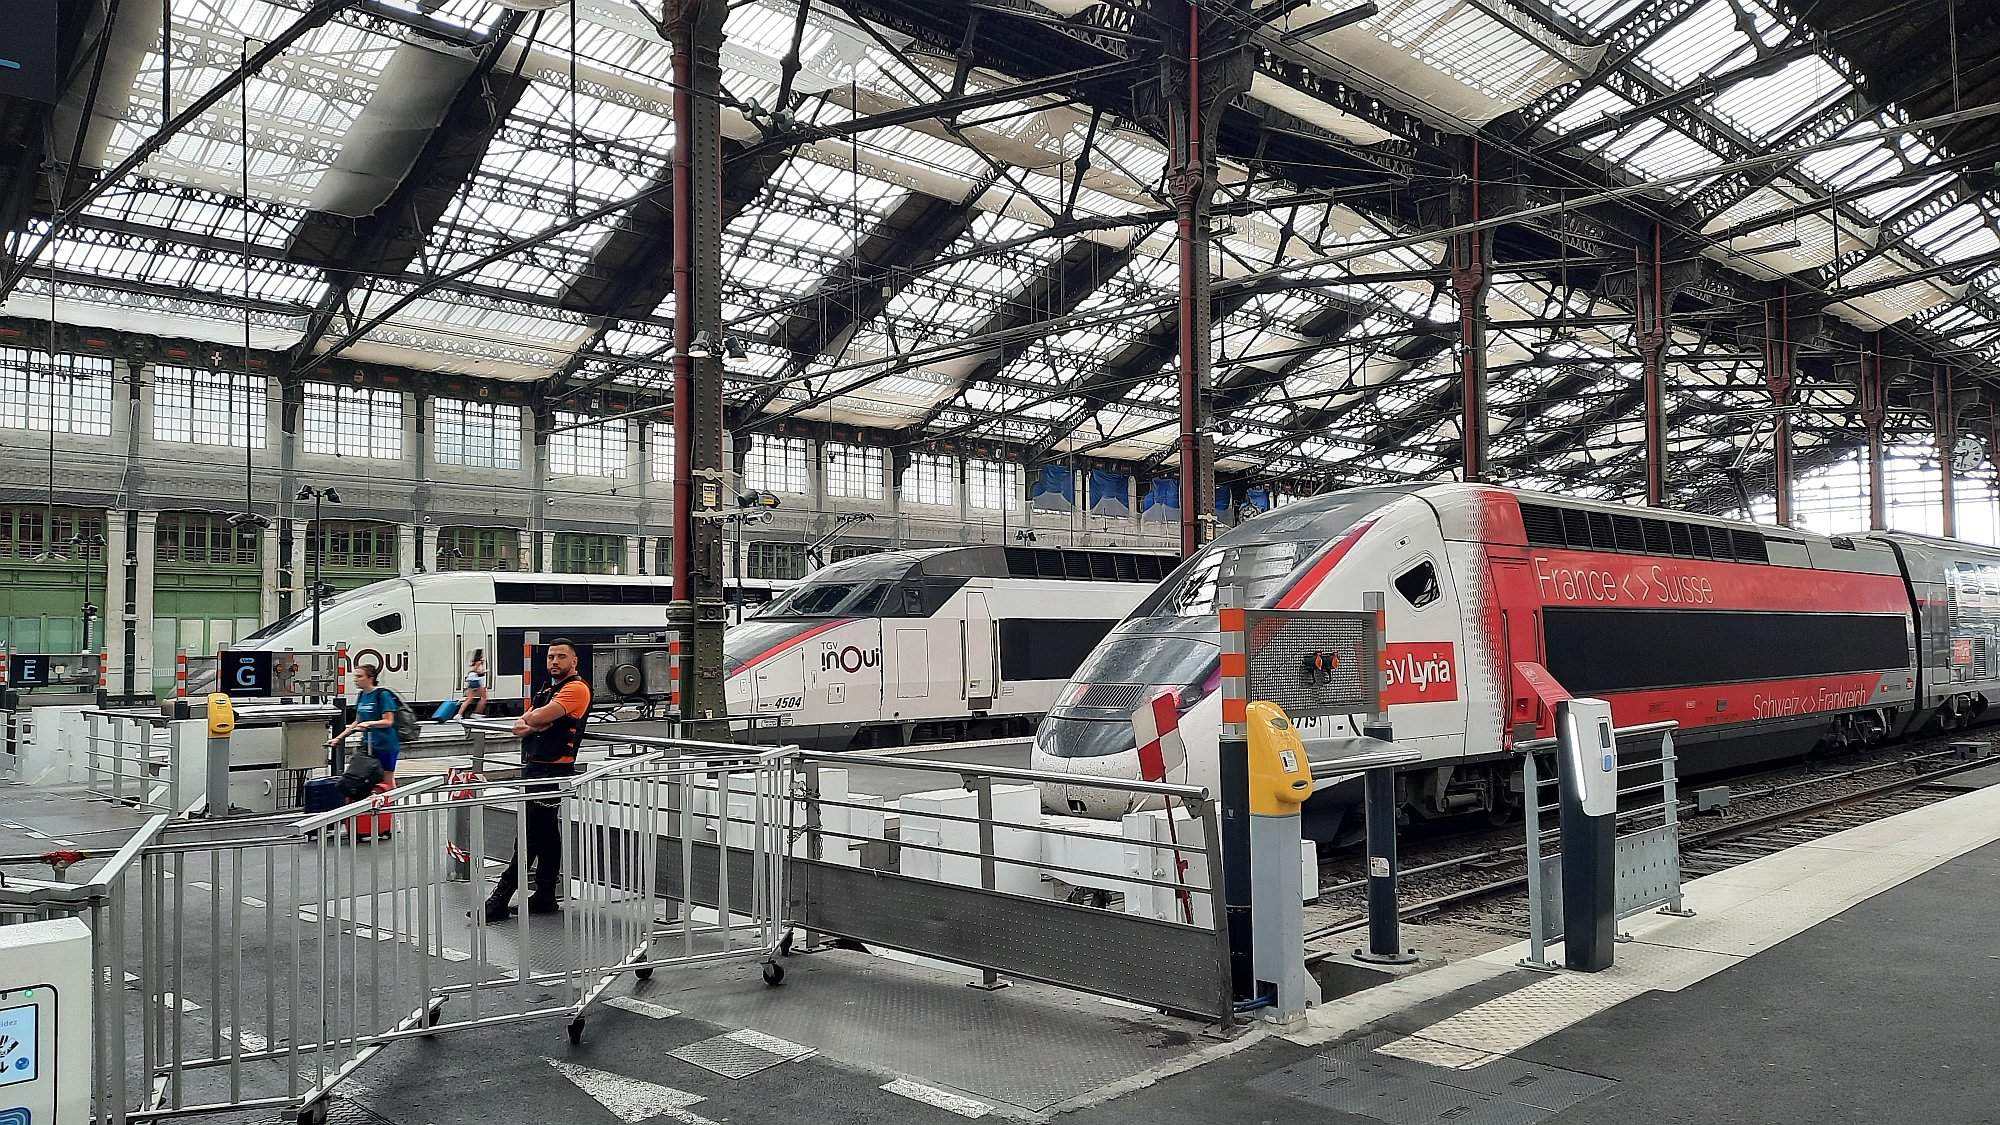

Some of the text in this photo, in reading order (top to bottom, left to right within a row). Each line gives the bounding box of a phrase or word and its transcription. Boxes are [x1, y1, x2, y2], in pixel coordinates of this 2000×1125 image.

[1534, 556, 1617, 601] France
[1651, 564, 1714, 604] Suisse
[821, 641, 838, 650] TGV
[24, 665, 36, 680] E
[236, 665, 256, 686] G
[1407, 652, 1451, 692] Lyria
[775, 696, 802, 709] 4504
[1752, 690, 1799, 720] Schweiz
[1818, 683, 1866, 712] Frankreich
